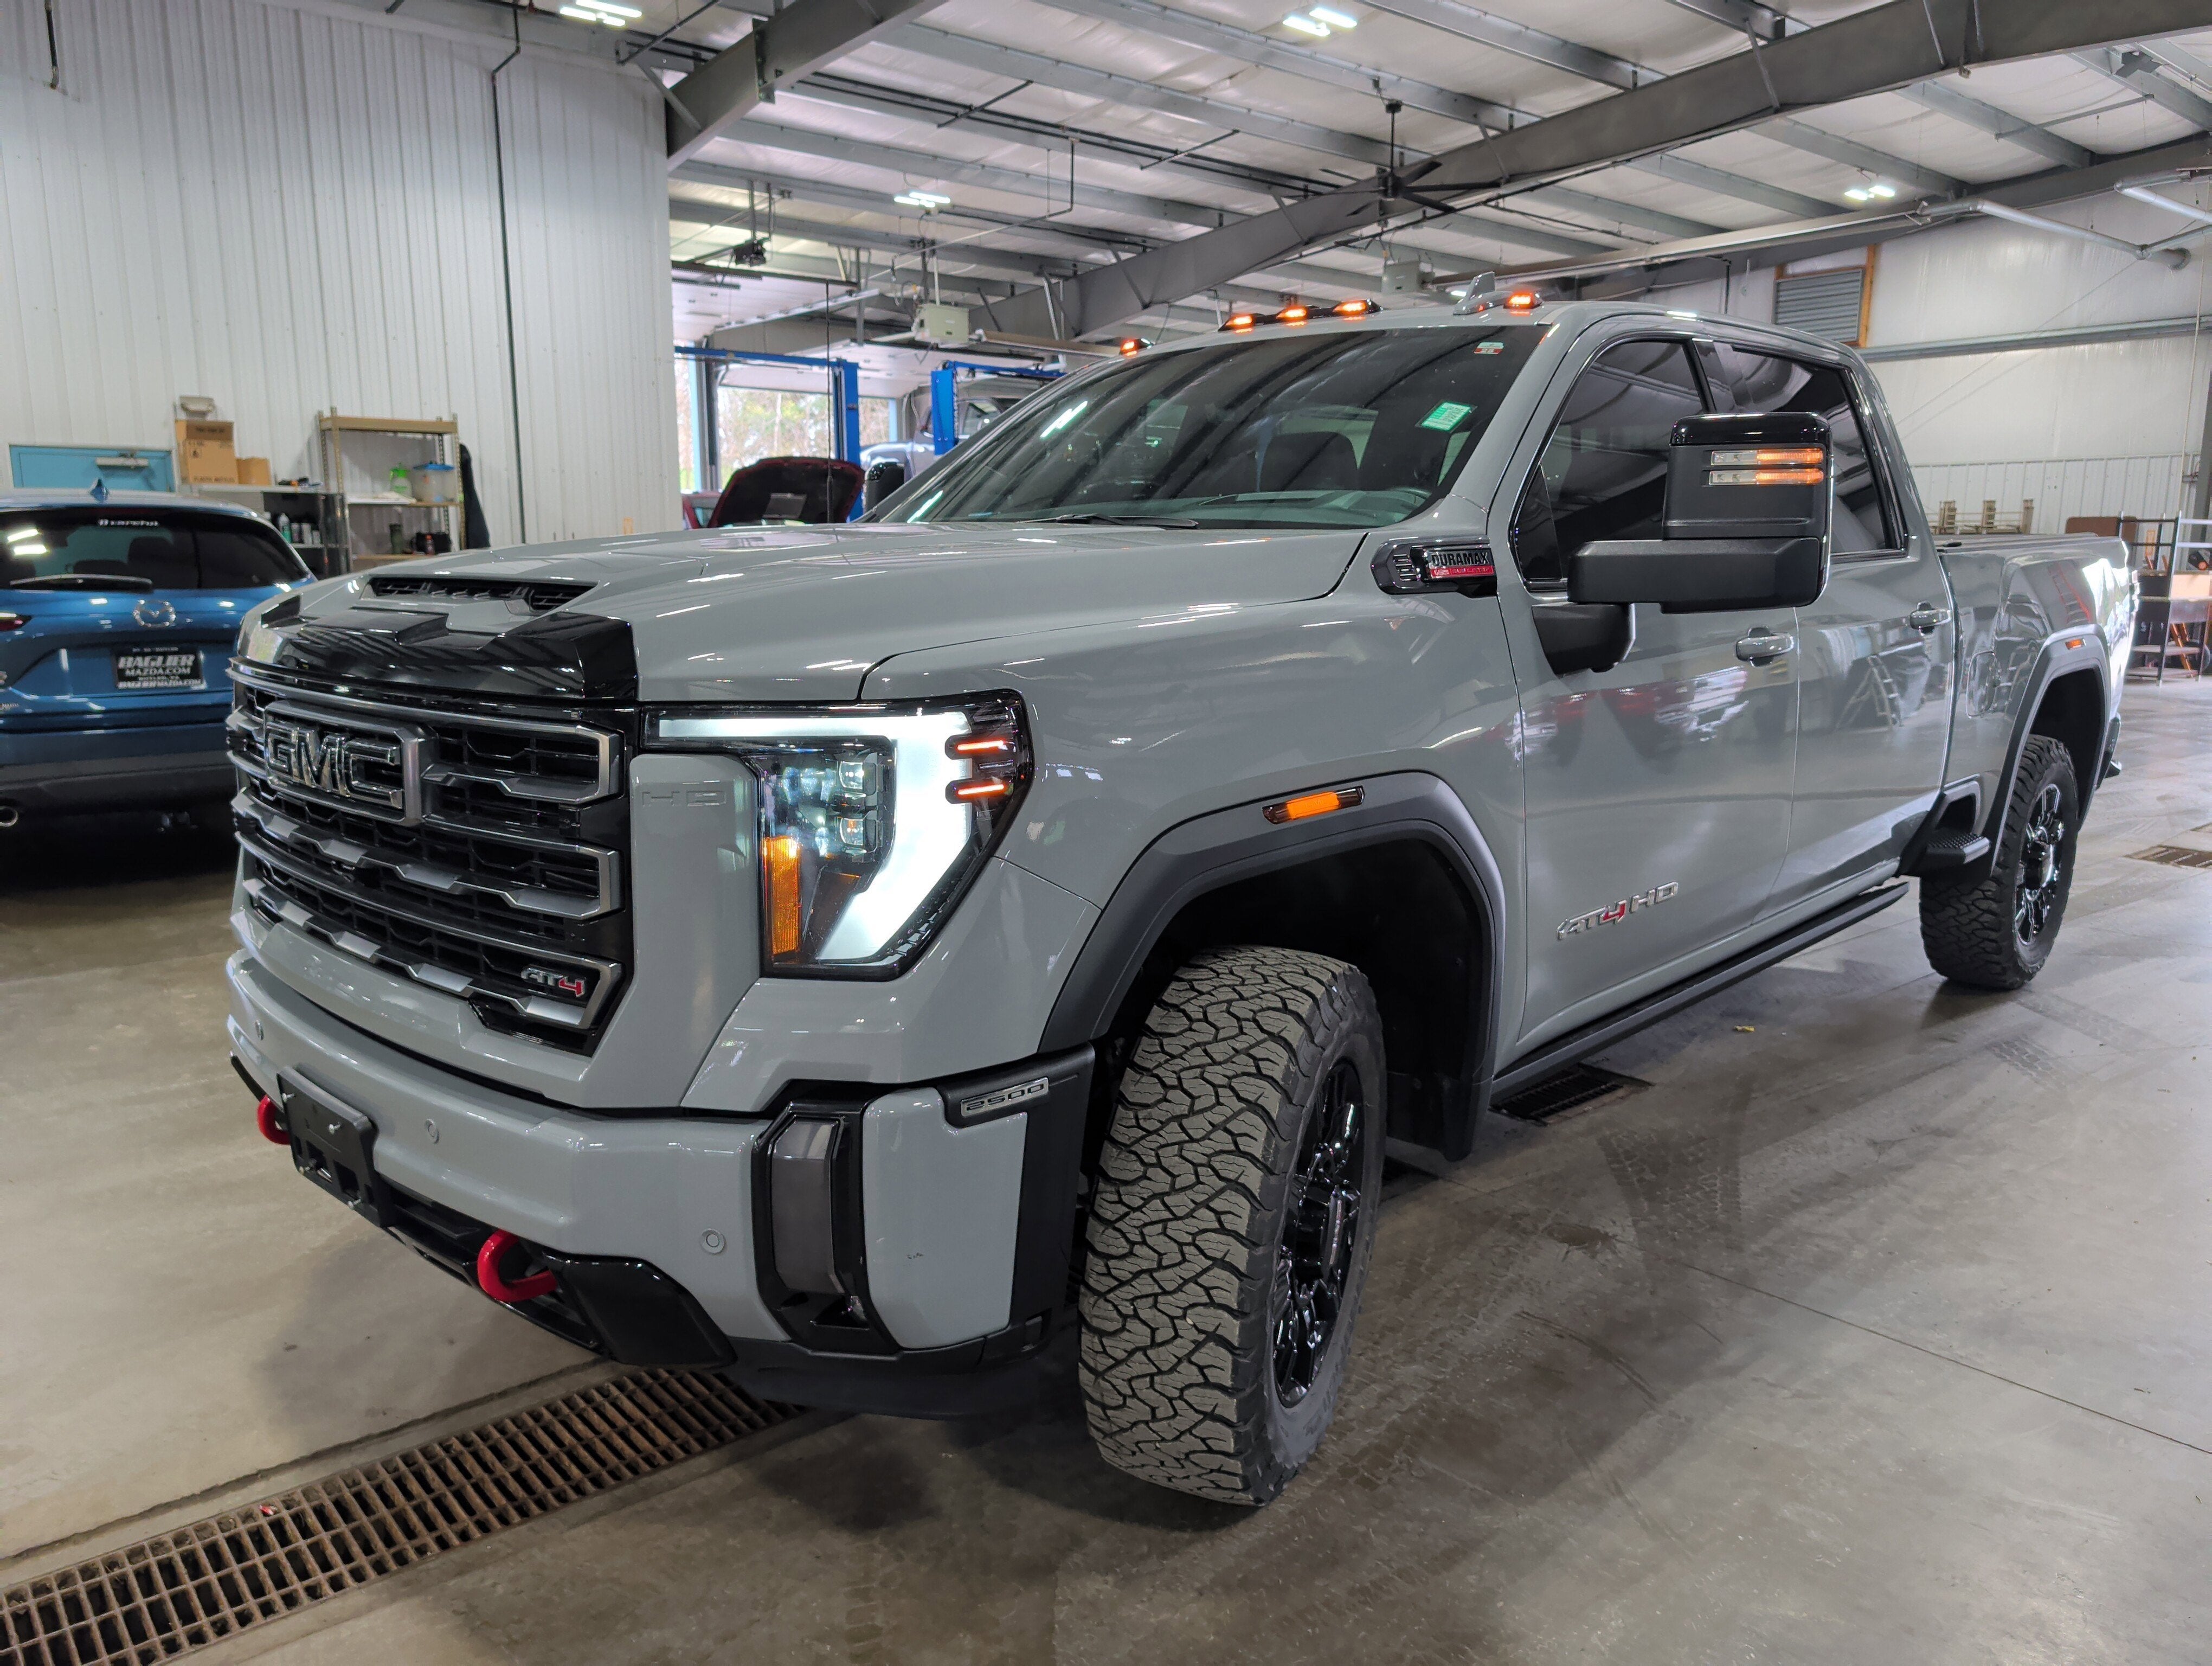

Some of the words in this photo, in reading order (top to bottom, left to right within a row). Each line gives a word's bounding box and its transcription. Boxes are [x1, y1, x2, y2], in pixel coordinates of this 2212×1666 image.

[1431, 552, 1489, 566] DURAMAX
[266, 722, 403, 809] GMC
[642, 791, 726, 807] HD
[1556, 899, 1626, 940] AT4
[1629, 882, 1679, 913] HD
[521, 967, 586, 997] AT4
[966, 1084, 1045, 1111] 2500
